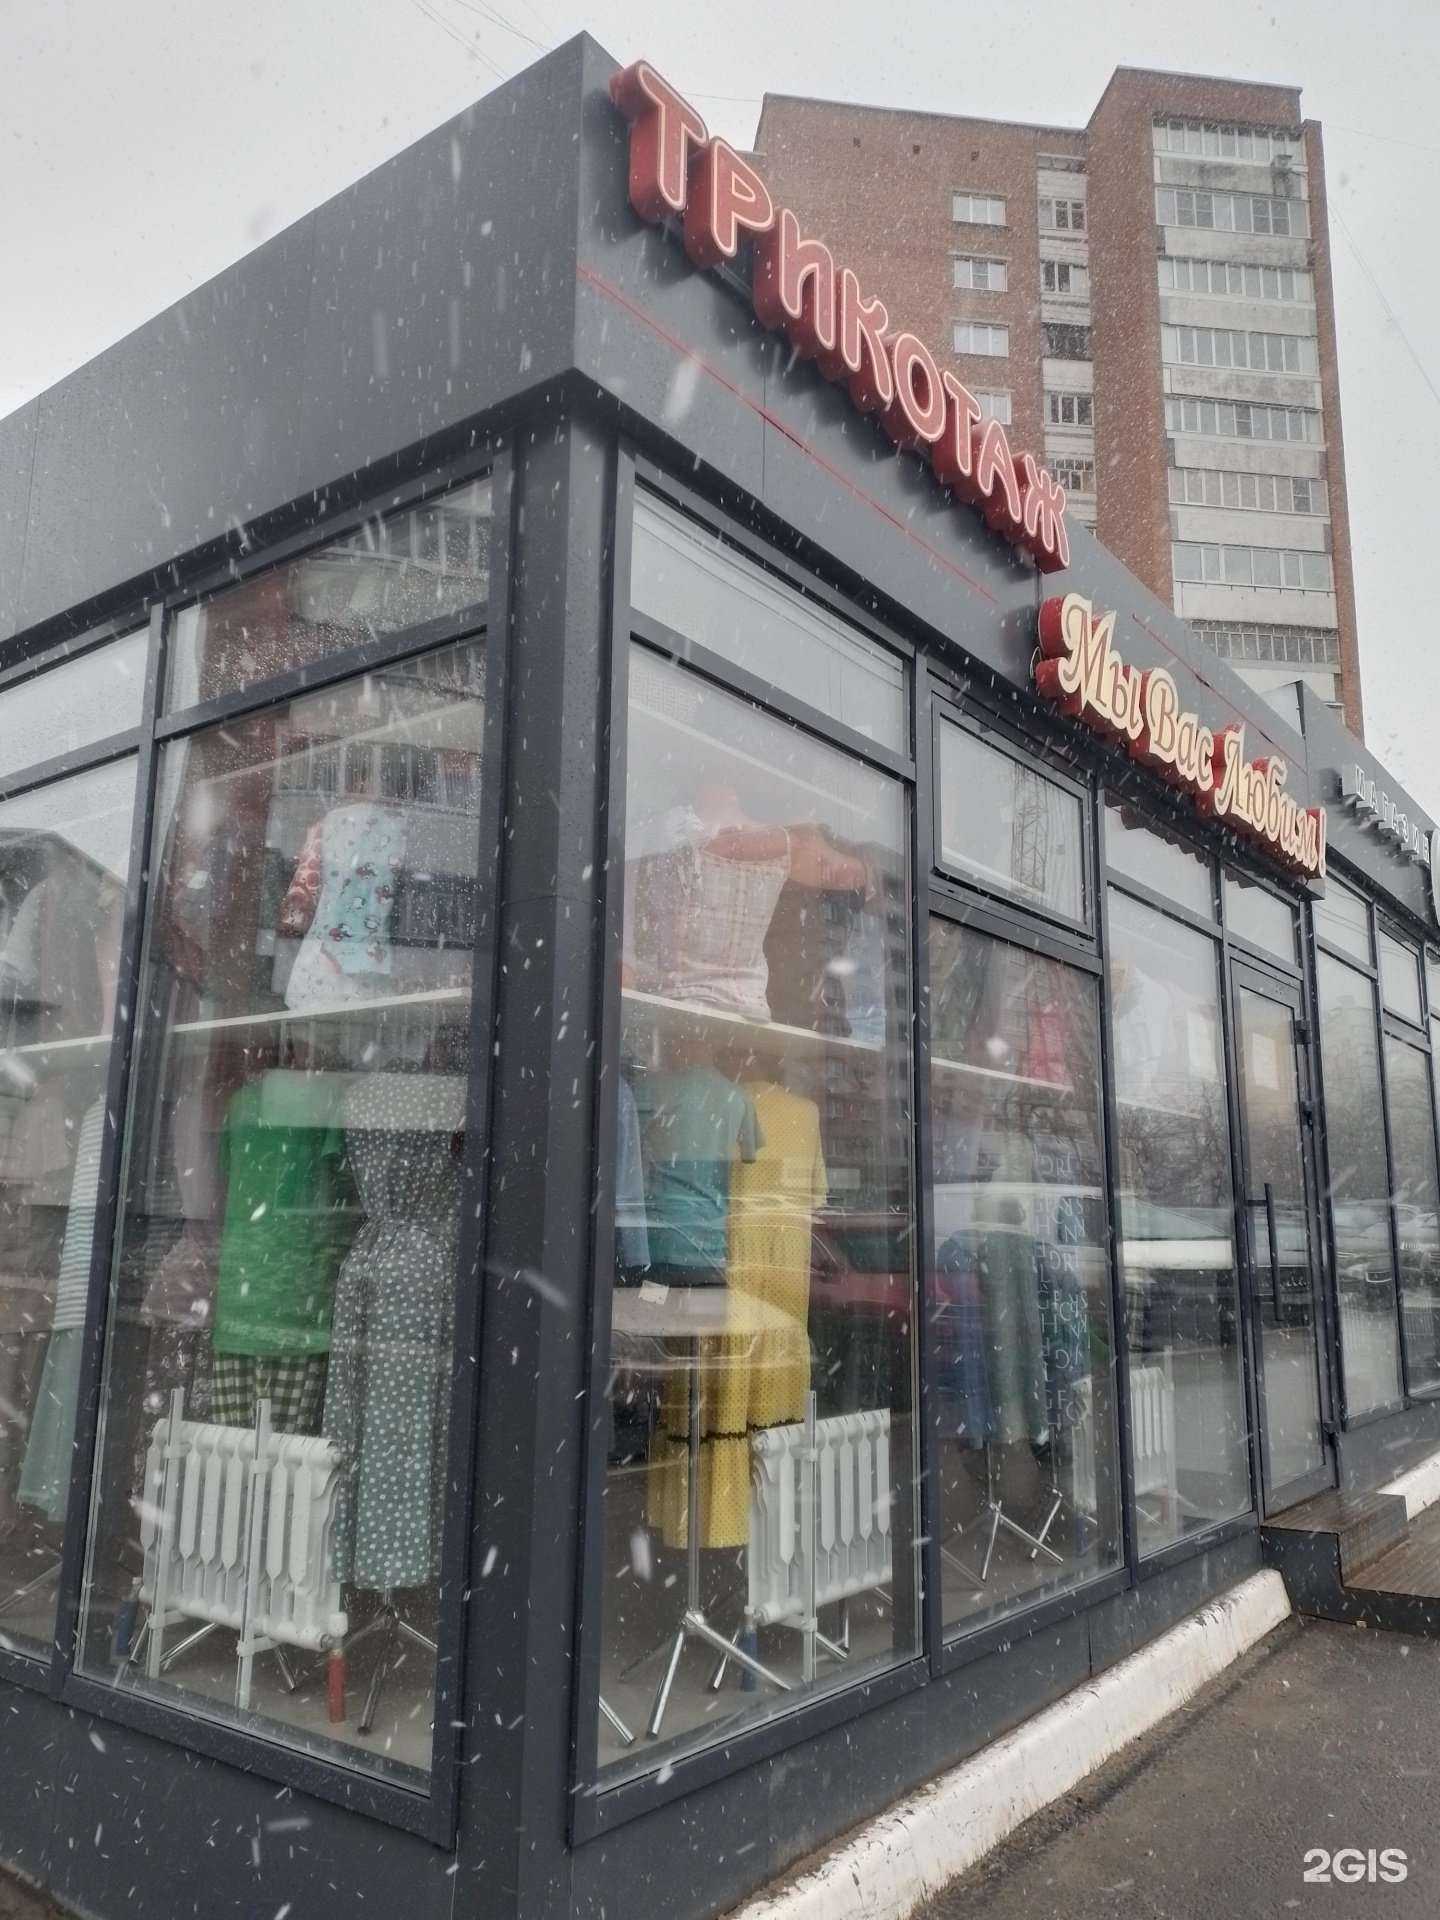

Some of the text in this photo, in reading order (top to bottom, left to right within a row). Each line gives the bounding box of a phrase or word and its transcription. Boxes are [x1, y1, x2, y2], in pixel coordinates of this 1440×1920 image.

[1057, 592, 1327, 879] Мы Вас Любим!
